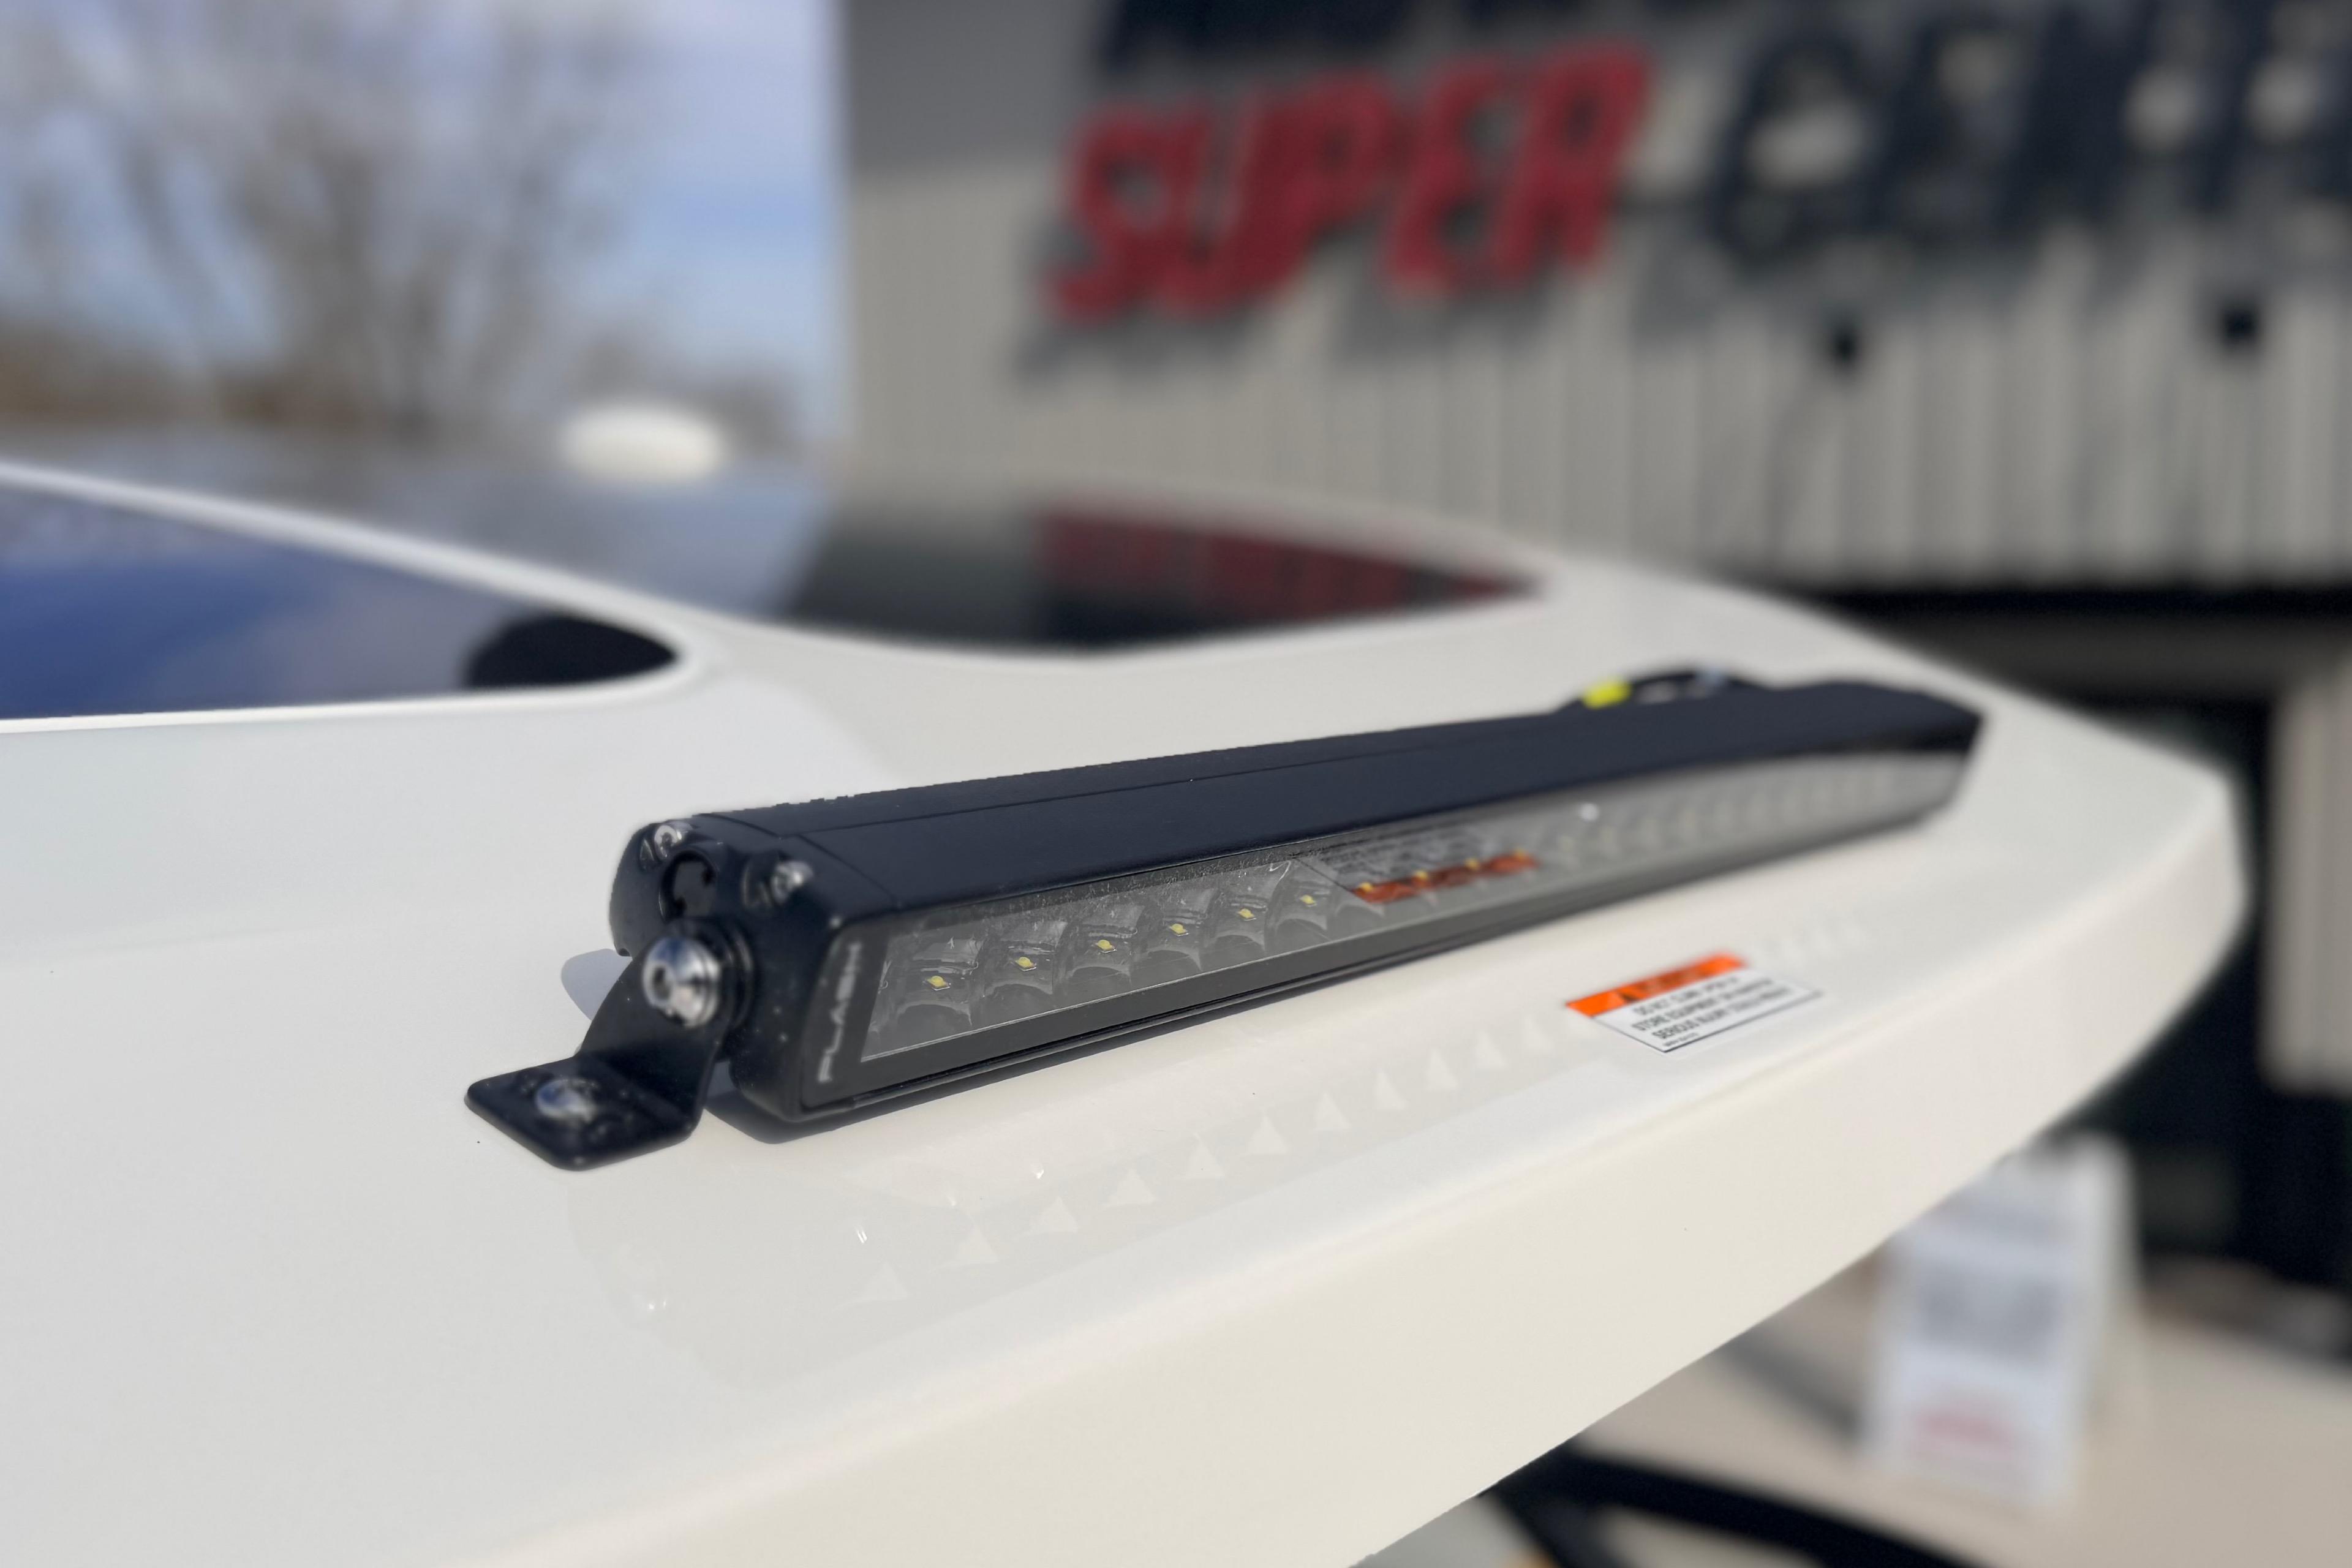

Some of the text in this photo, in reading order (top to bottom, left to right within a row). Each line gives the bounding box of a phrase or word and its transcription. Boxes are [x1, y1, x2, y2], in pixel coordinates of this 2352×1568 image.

[1046, 40, 1649, 326] SUPER
[1630, 1015, 1671, 1031] STORE
[1651, 1019, 1700, 1039] SERIOUS
